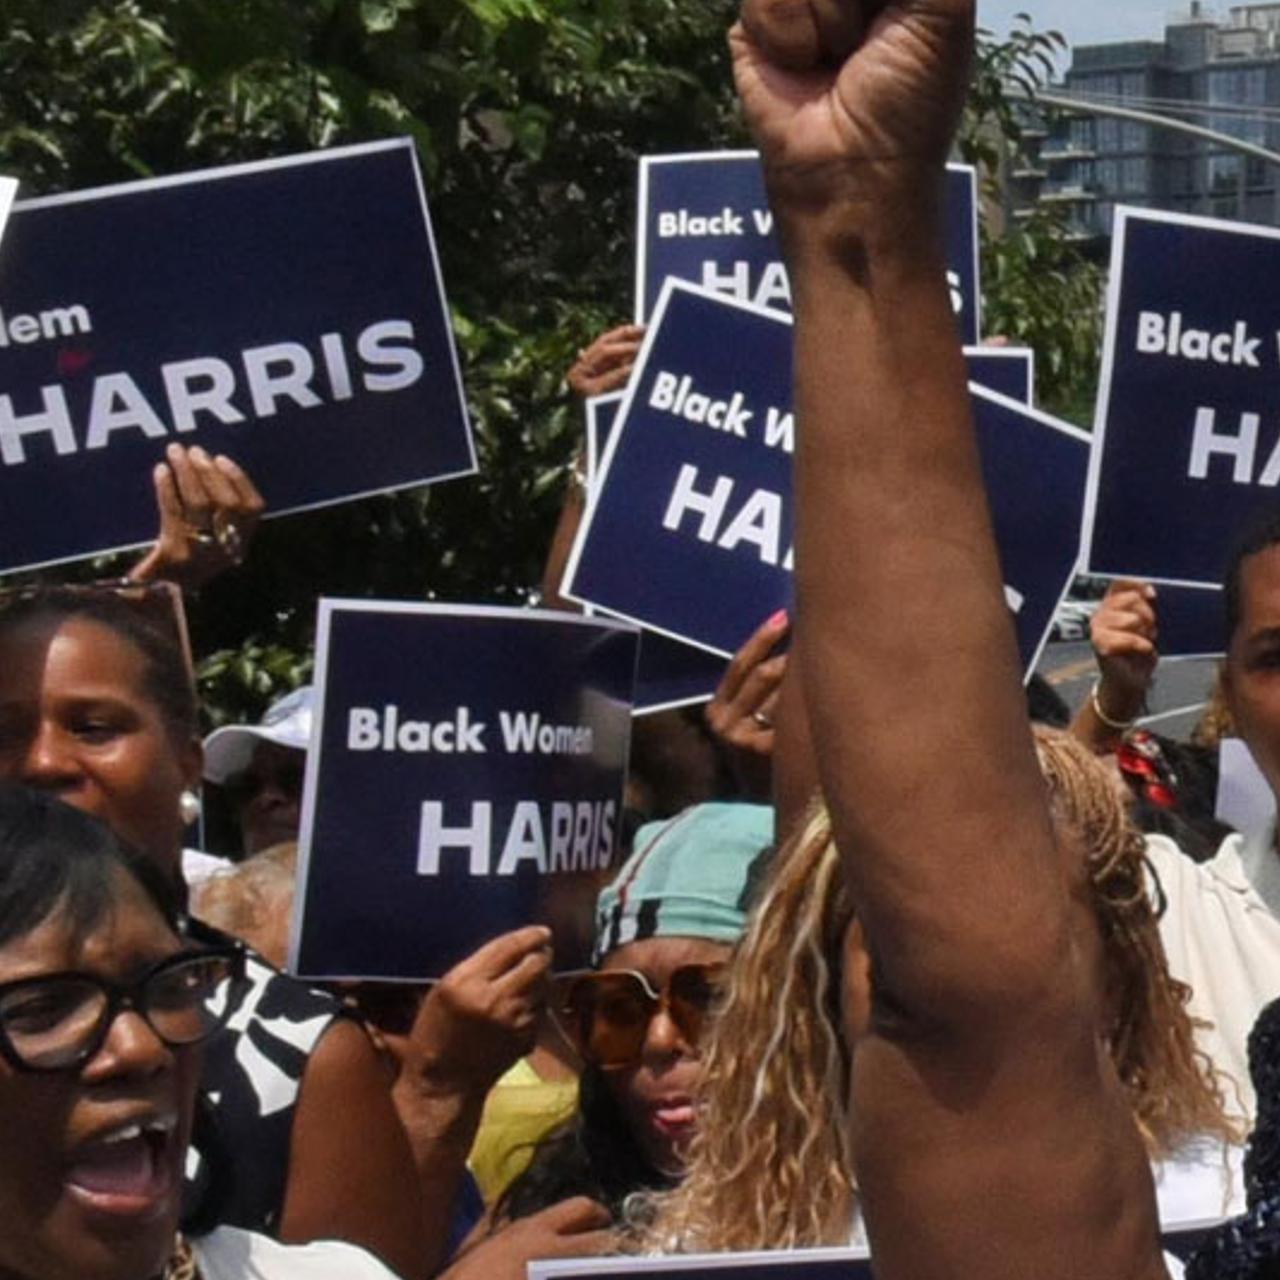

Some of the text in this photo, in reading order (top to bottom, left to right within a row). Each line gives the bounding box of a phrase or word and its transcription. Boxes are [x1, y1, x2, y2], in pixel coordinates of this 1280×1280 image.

[658, 208, 744, 237] Black
[1136, 311, 1259, 367] Black
[0, 320, 424, 467] HARRIS
[649, 371, 752, 437] Black
[348, 706, 594, 754] Black Women
[417, 800, 616, 876] HARRIS
